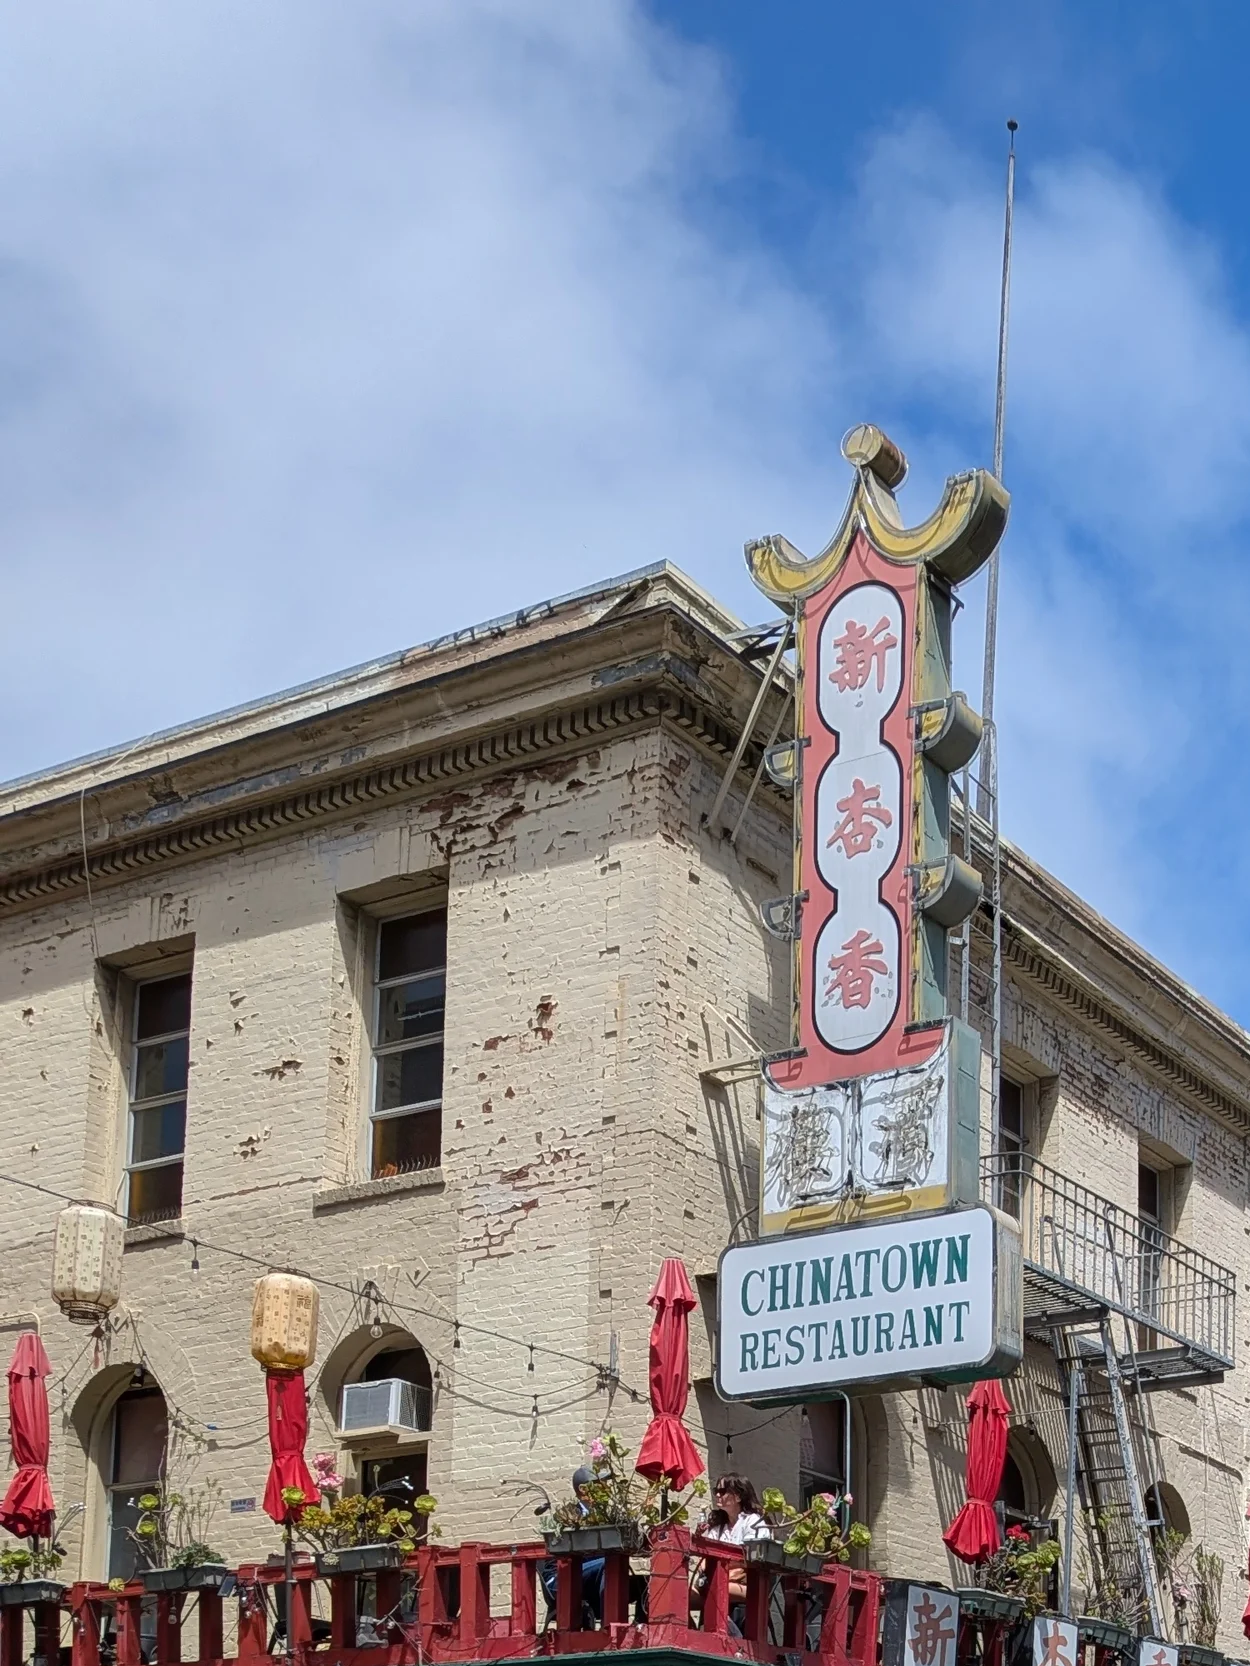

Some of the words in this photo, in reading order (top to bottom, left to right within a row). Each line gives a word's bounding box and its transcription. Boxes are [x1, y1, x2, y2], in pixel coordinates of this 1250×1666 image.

[827, 616, 898, 1010] 新杏香
[740, 1234, 971, 1317] CHINATOWN
[739, 1301, 970, 1372] RESTAURANT
